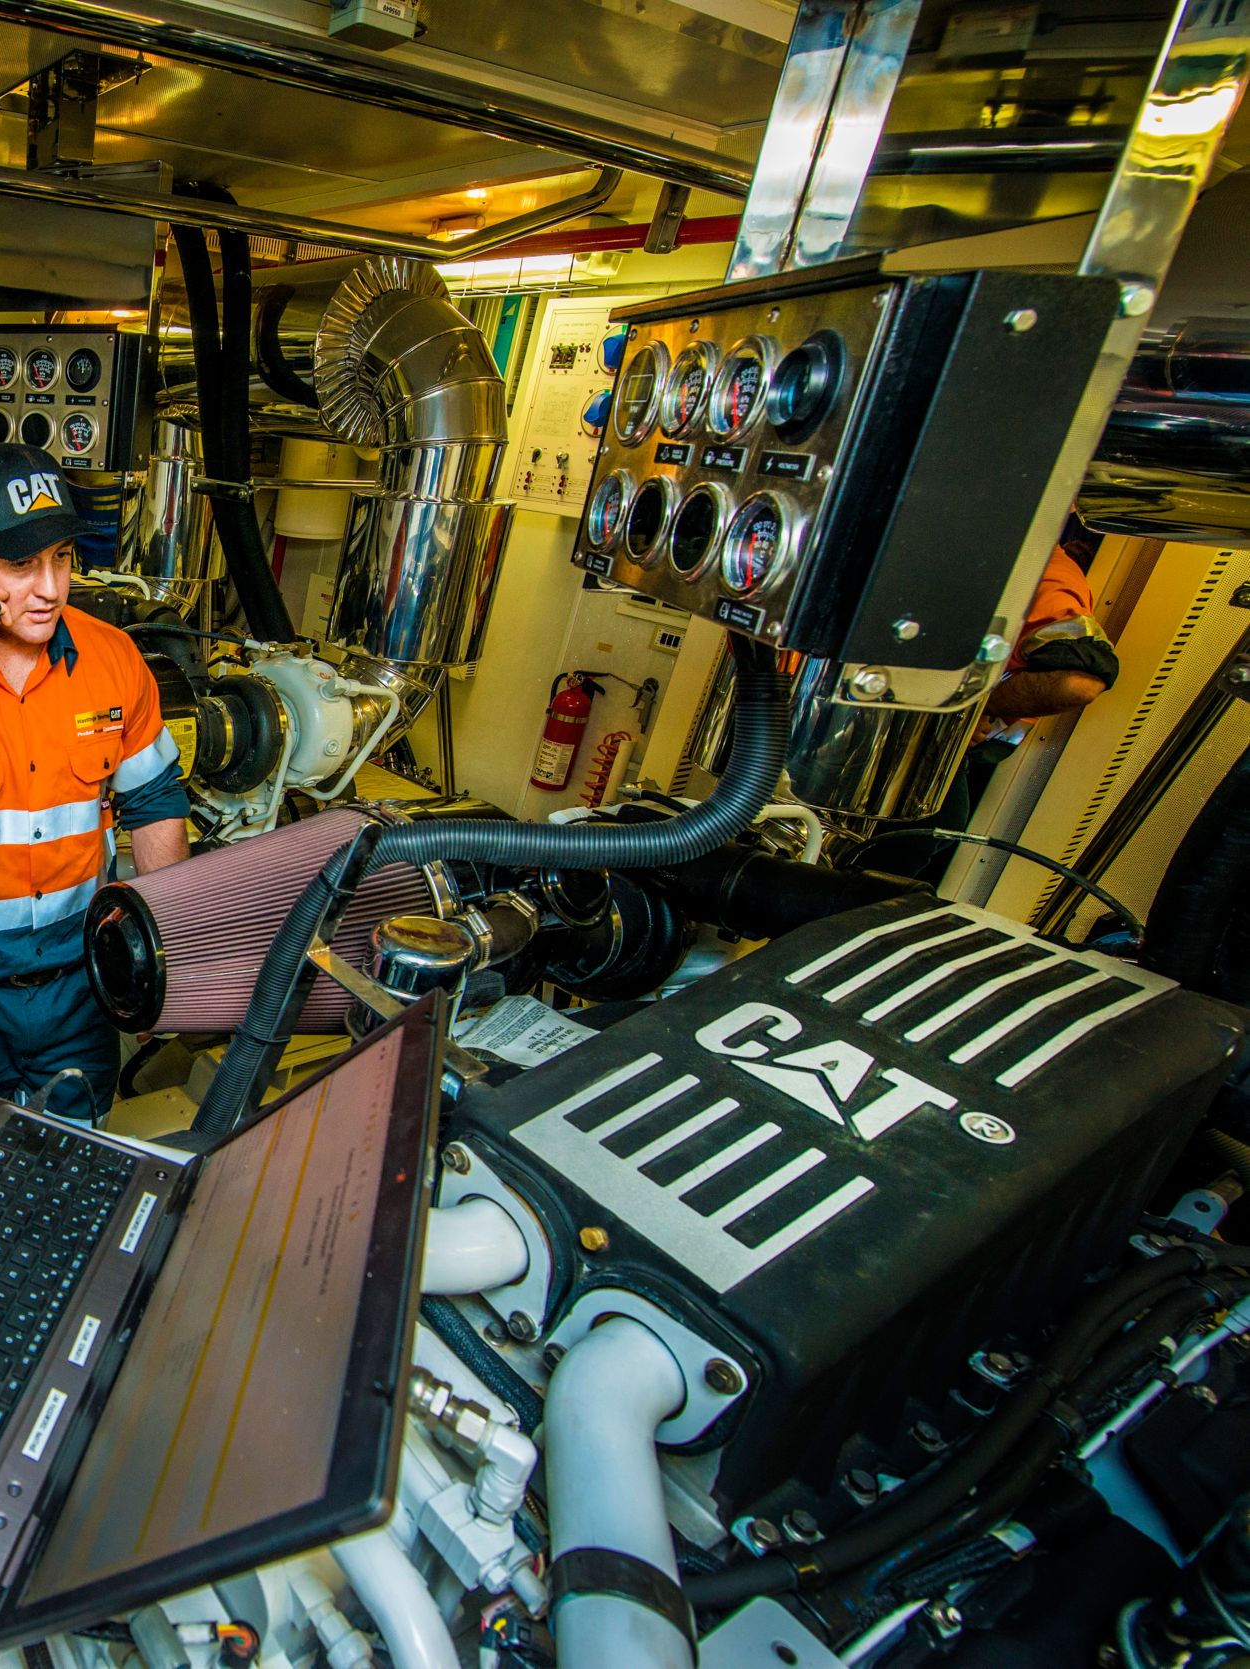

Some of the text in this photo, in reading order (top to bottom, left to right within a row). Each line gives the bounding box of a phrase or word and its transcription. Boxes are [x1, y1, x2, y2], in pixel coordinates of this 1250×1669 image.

[7, 472, 62, 515] CAT
[111, 709, 121, 719] CAT
[695, 1001, 959, 1141] CAT
